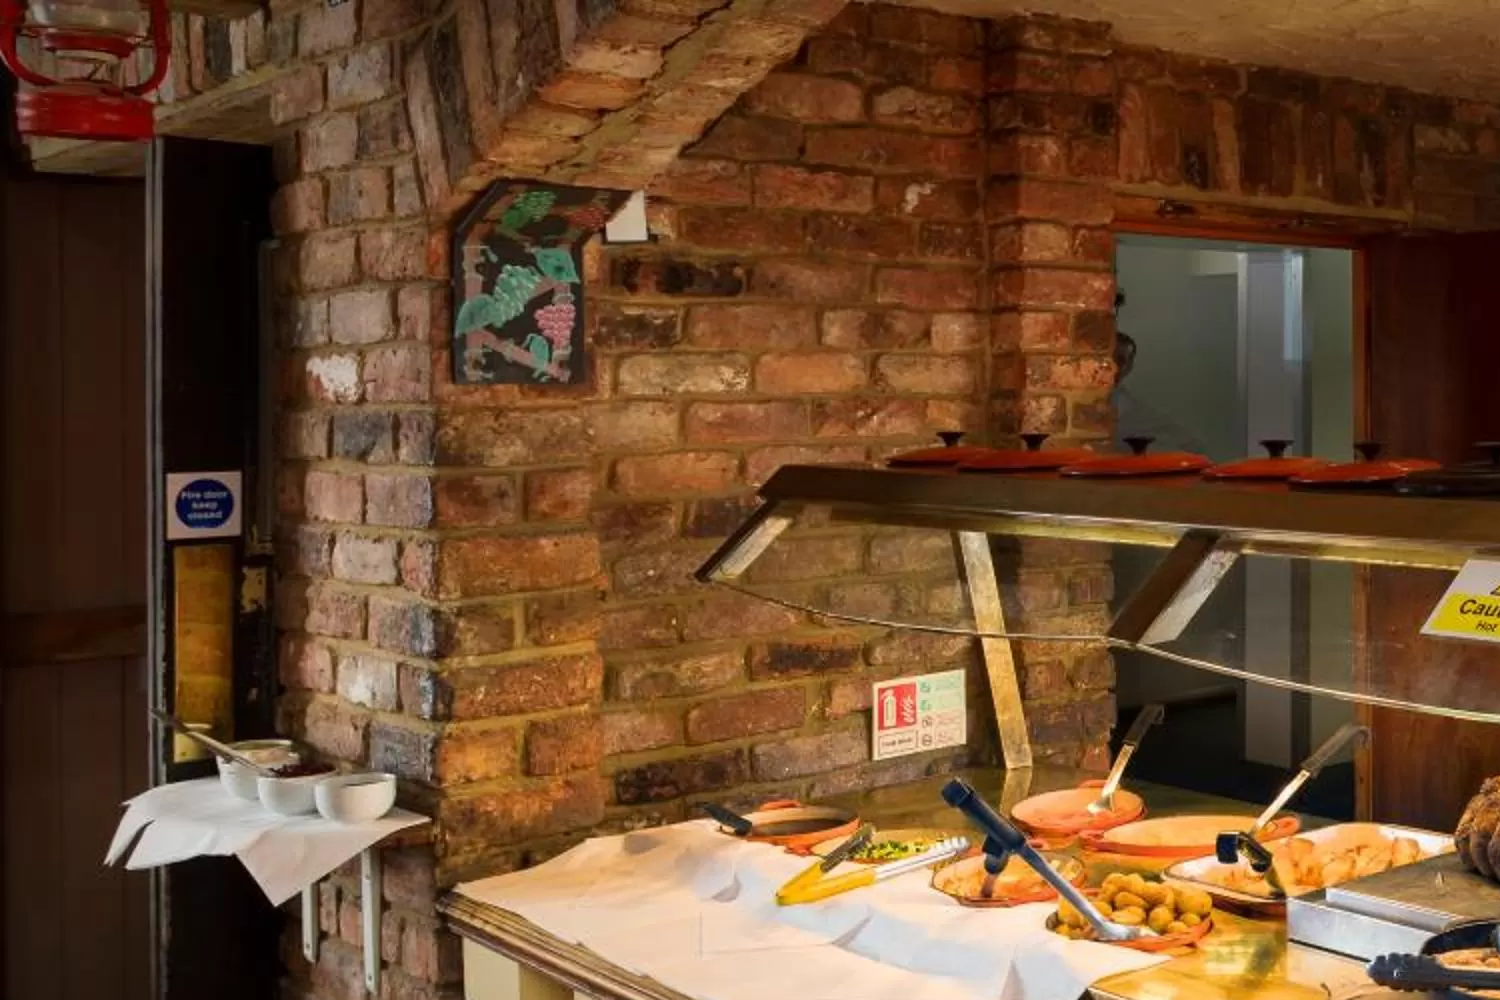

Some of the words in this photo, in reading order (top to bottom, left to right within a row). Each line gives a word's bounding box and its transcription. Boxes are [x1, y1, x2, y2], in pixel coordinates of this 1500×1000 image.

[181, 491, 201, 500] Fire
[203, 490, 228, 500] door
[191, 501, 218, 511] keep
[187, 510, 223, 521] closed
[1475, 620, 1499, 632] Hot
